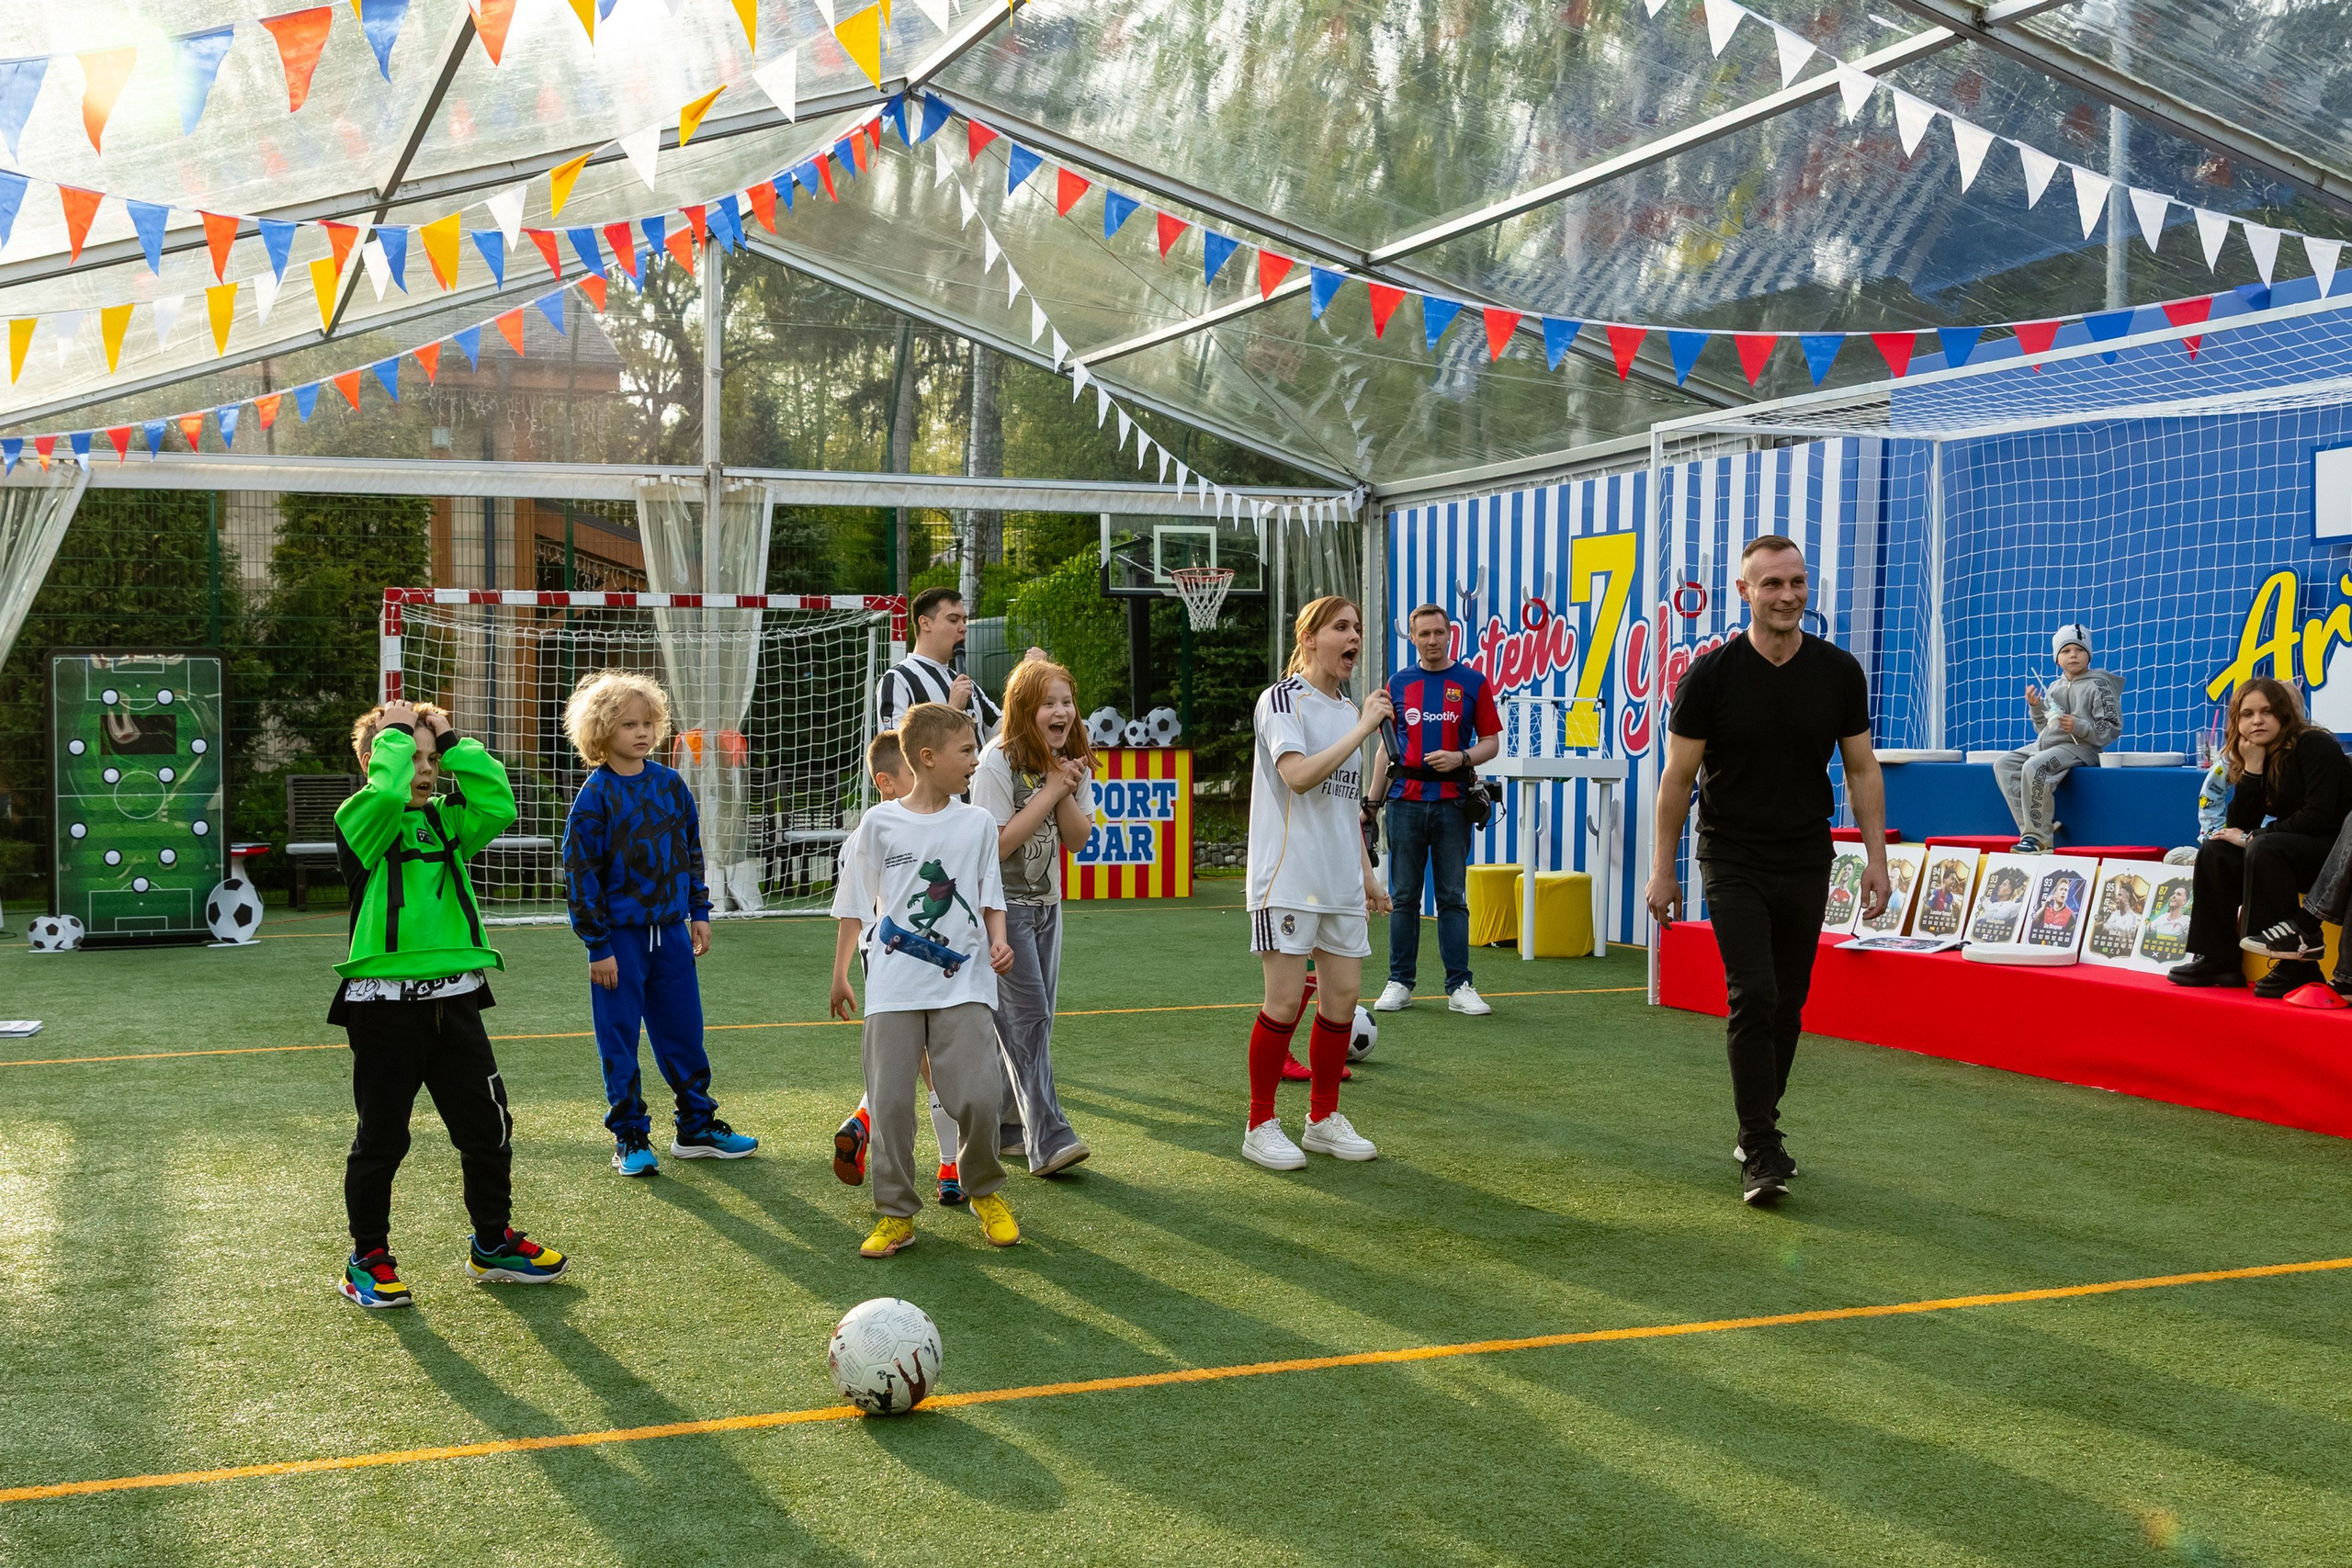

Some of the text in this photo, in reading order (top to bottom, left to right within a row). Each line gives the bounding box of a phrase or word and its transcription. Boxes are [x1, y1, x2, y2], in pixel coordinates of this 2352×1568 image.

[1566, 532, 1636, 747] 7
[1422, 711, 1459, 723] Spotify
[1077, 825, 1153, 862] BAR
[1932, 867, 1940, 875] 94
[1989, 874, 1998, 884] 93
[2043, 878, 2053, 886] 93
[2105, 883, 2115, 892] 95
[2158, 886, 2168, 895] 87
